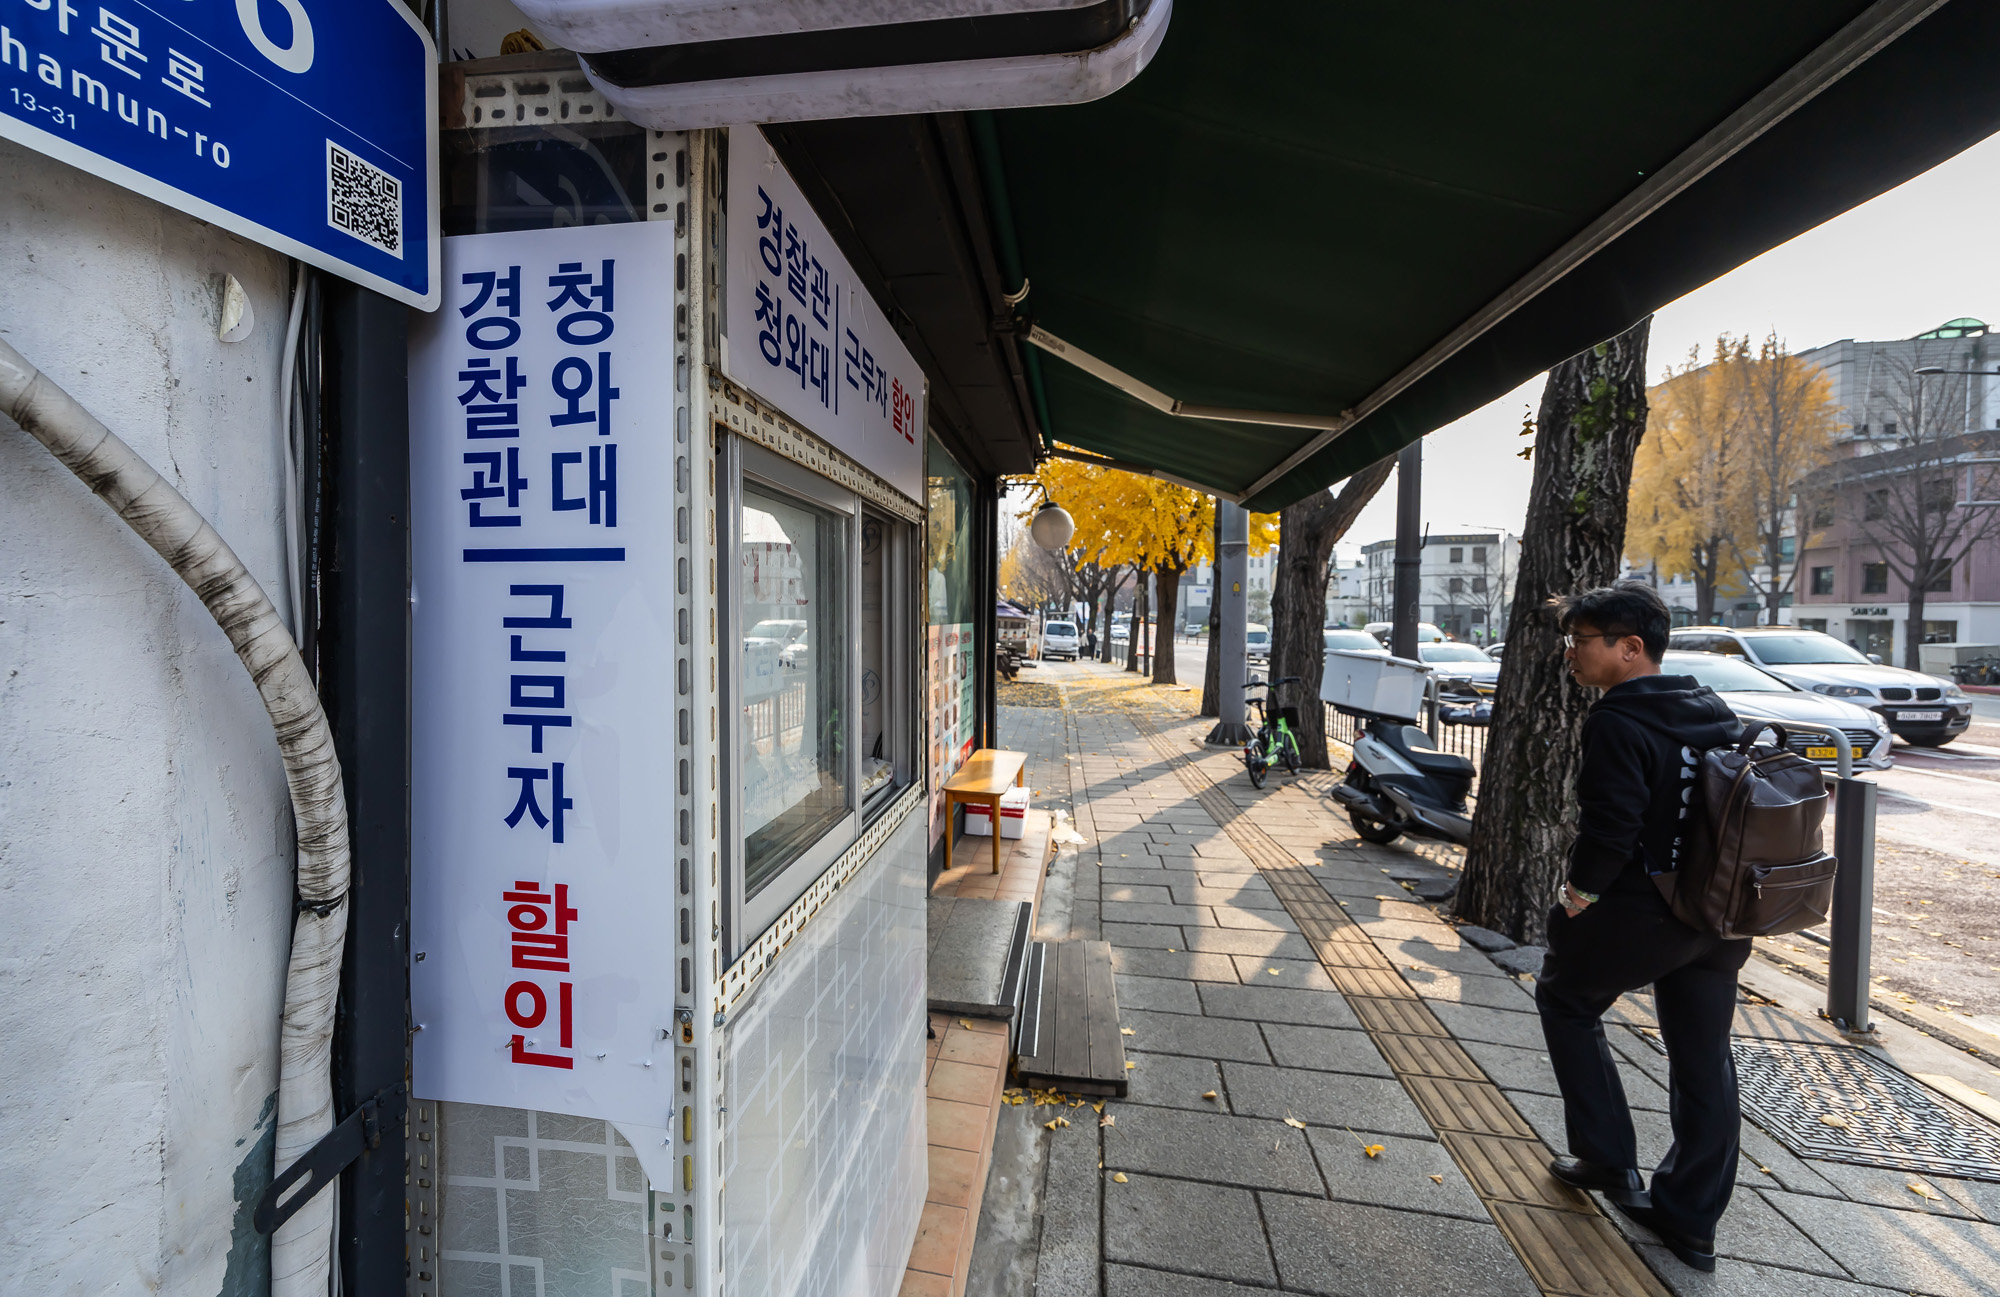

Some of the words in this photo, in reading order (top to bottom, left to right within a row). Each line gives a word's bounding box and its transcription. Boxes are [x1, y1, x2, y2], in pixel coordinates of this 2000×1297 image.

[10, 87, 76, 130] 13-31
[756, 184, 831, 330] 경찰관
[457, 265, 529, 528] 경찰관
[546, 259, 620, 528] 청와대
[754, 280, 829, 409] 청와대
[844, 326, 888, 419] 근무자
[891, 376, 915, 446] 할인
[502, 584, 573, 844] 근무자
[503, 880, 578, 1070] 할인
